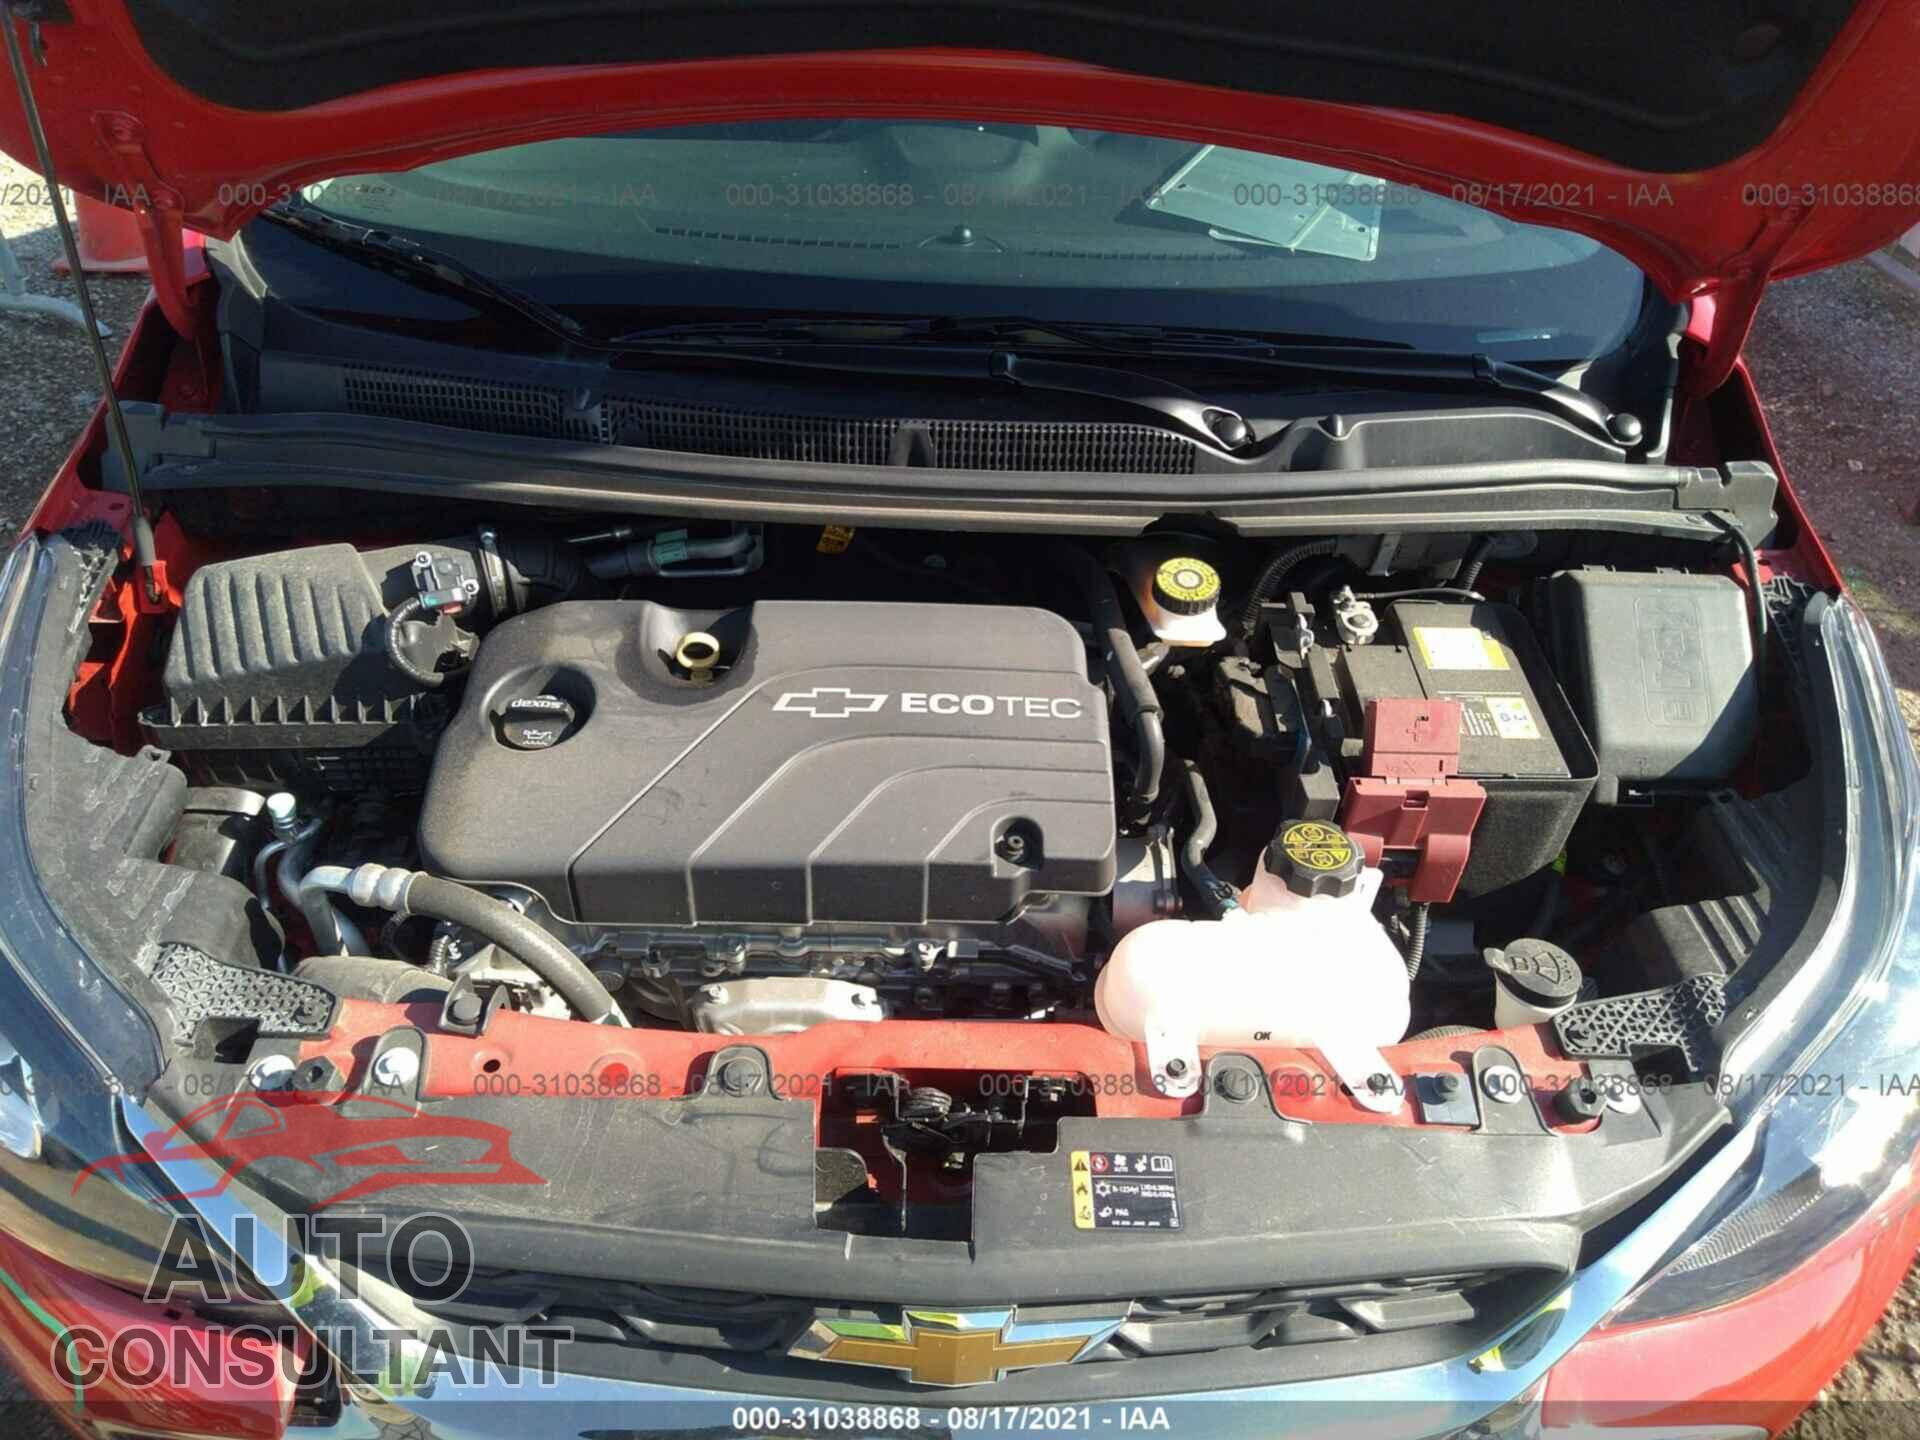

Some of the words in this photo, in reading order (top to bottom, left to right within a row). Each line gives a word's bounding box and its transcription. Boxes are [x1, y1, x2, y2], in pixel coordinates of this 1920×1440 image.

[511, 698, 564, 708] dexos
[901, 693, 1082, 718] ECOTEC
[1254, 1031, 1272, 1041] OK
